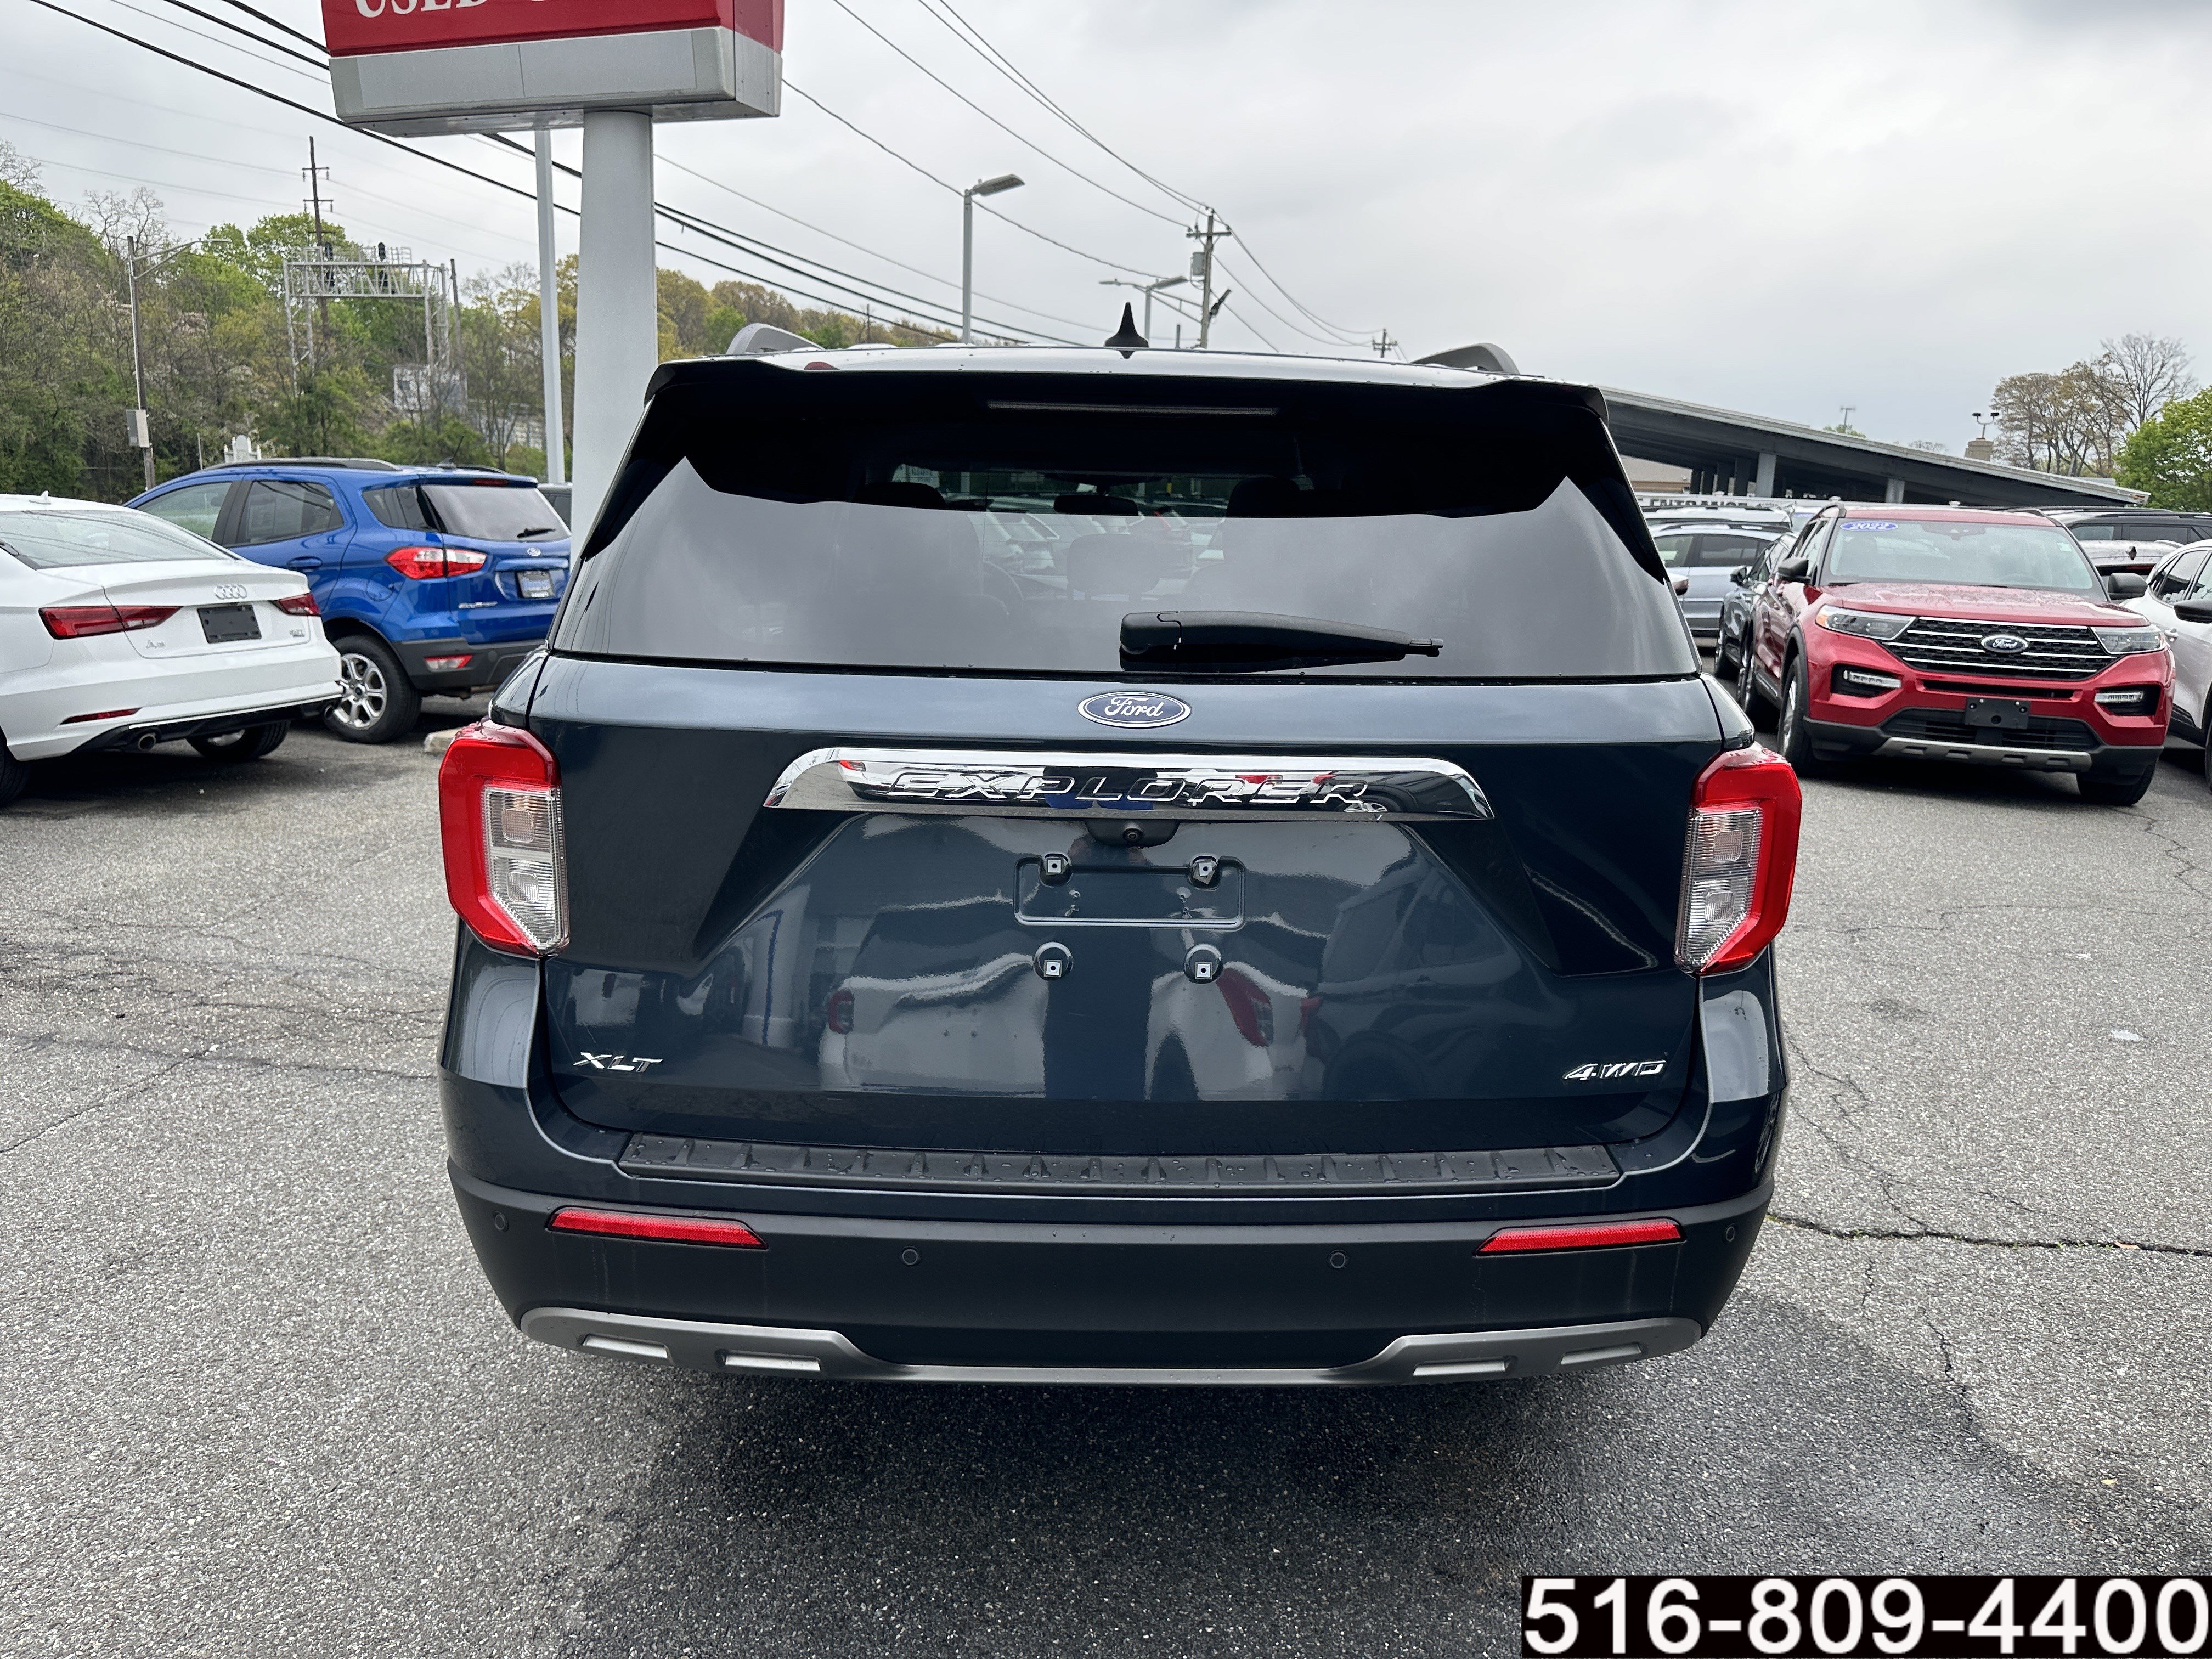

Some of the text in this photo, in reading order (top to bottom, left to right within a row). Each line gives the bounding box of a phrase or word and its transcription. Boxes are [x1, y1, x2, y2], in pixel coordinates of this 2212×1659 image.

[356, 0, 488, 18] US
[1992, 638, 2018, 649] Ford
[1104, 696, 1164, 717] Ford
[888, 773, 1368, 803] EXPLORER
[572, 1052, 663, 1073] XLT
[1562, 1060, 1666, 1080] 4WD
